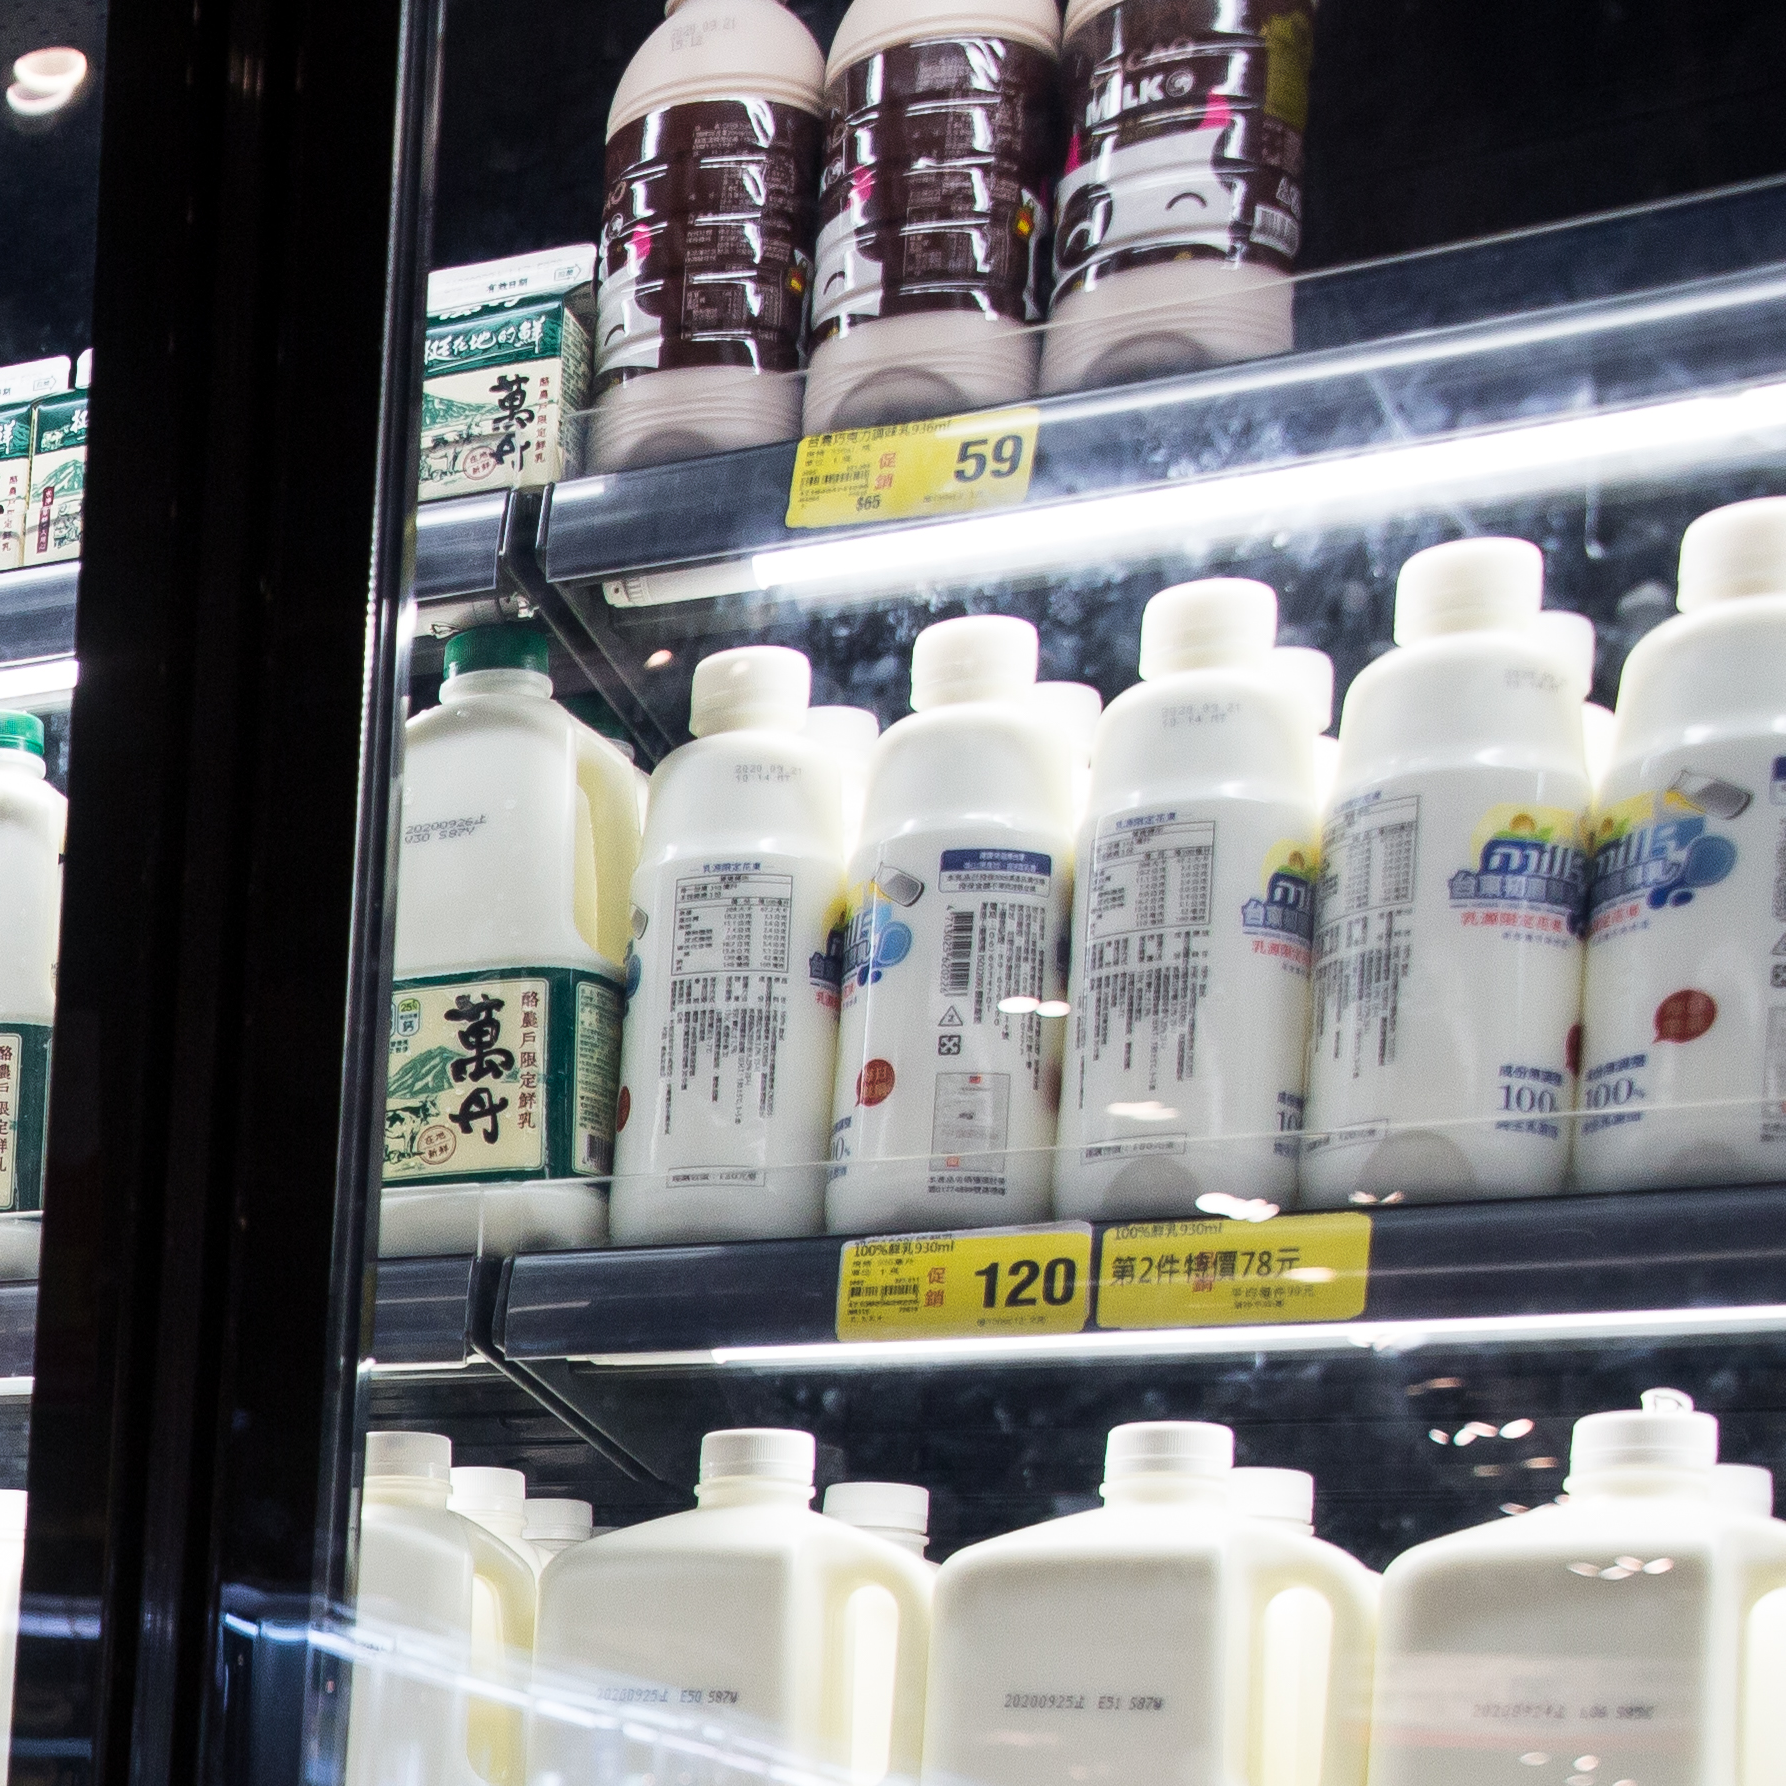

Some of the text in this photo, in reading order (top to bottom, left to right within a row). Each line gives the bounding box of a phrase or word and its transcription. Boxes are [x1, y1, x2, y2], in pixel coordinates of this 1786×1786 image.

[489, 374, 534, 472] 萬丹
[954, 435, 1023, 483] 59
[856, 495, 881, 511] $65
[444, 994, 515, 1145] 萬丹
[517, 991, 541, 1129] 酪農戶限定鮮乳
[924, 1267, 946, 1307] 促銷
[975, 1257, 1076, 1308] 120
